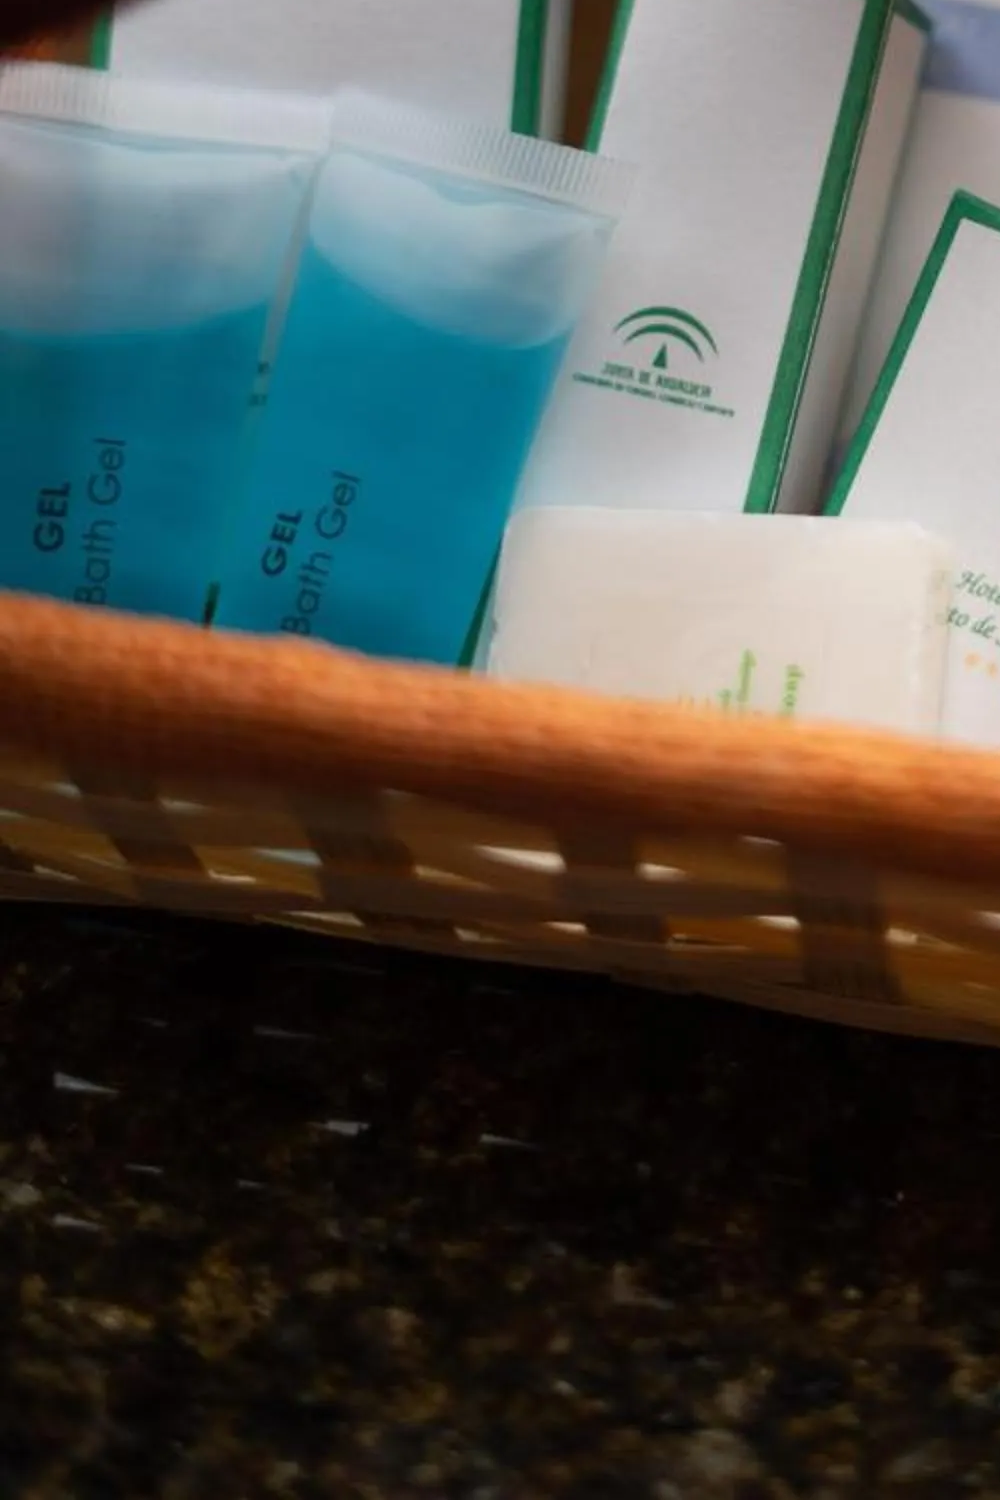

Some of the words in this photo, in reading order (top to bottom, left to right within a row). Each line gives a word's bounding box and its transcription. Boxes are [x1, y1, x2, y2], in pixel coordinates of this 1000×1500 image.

[86, 437, 127, 506] Gel
[34, 481, 71, 552] GEL
[261, 509, 303, 577] GEL
[74, 519, 118, 605] Bath
[280, 550, 332, 637] Bath
[314, 470, 362, 540] Gel
[970, 614, 997, 639] de
